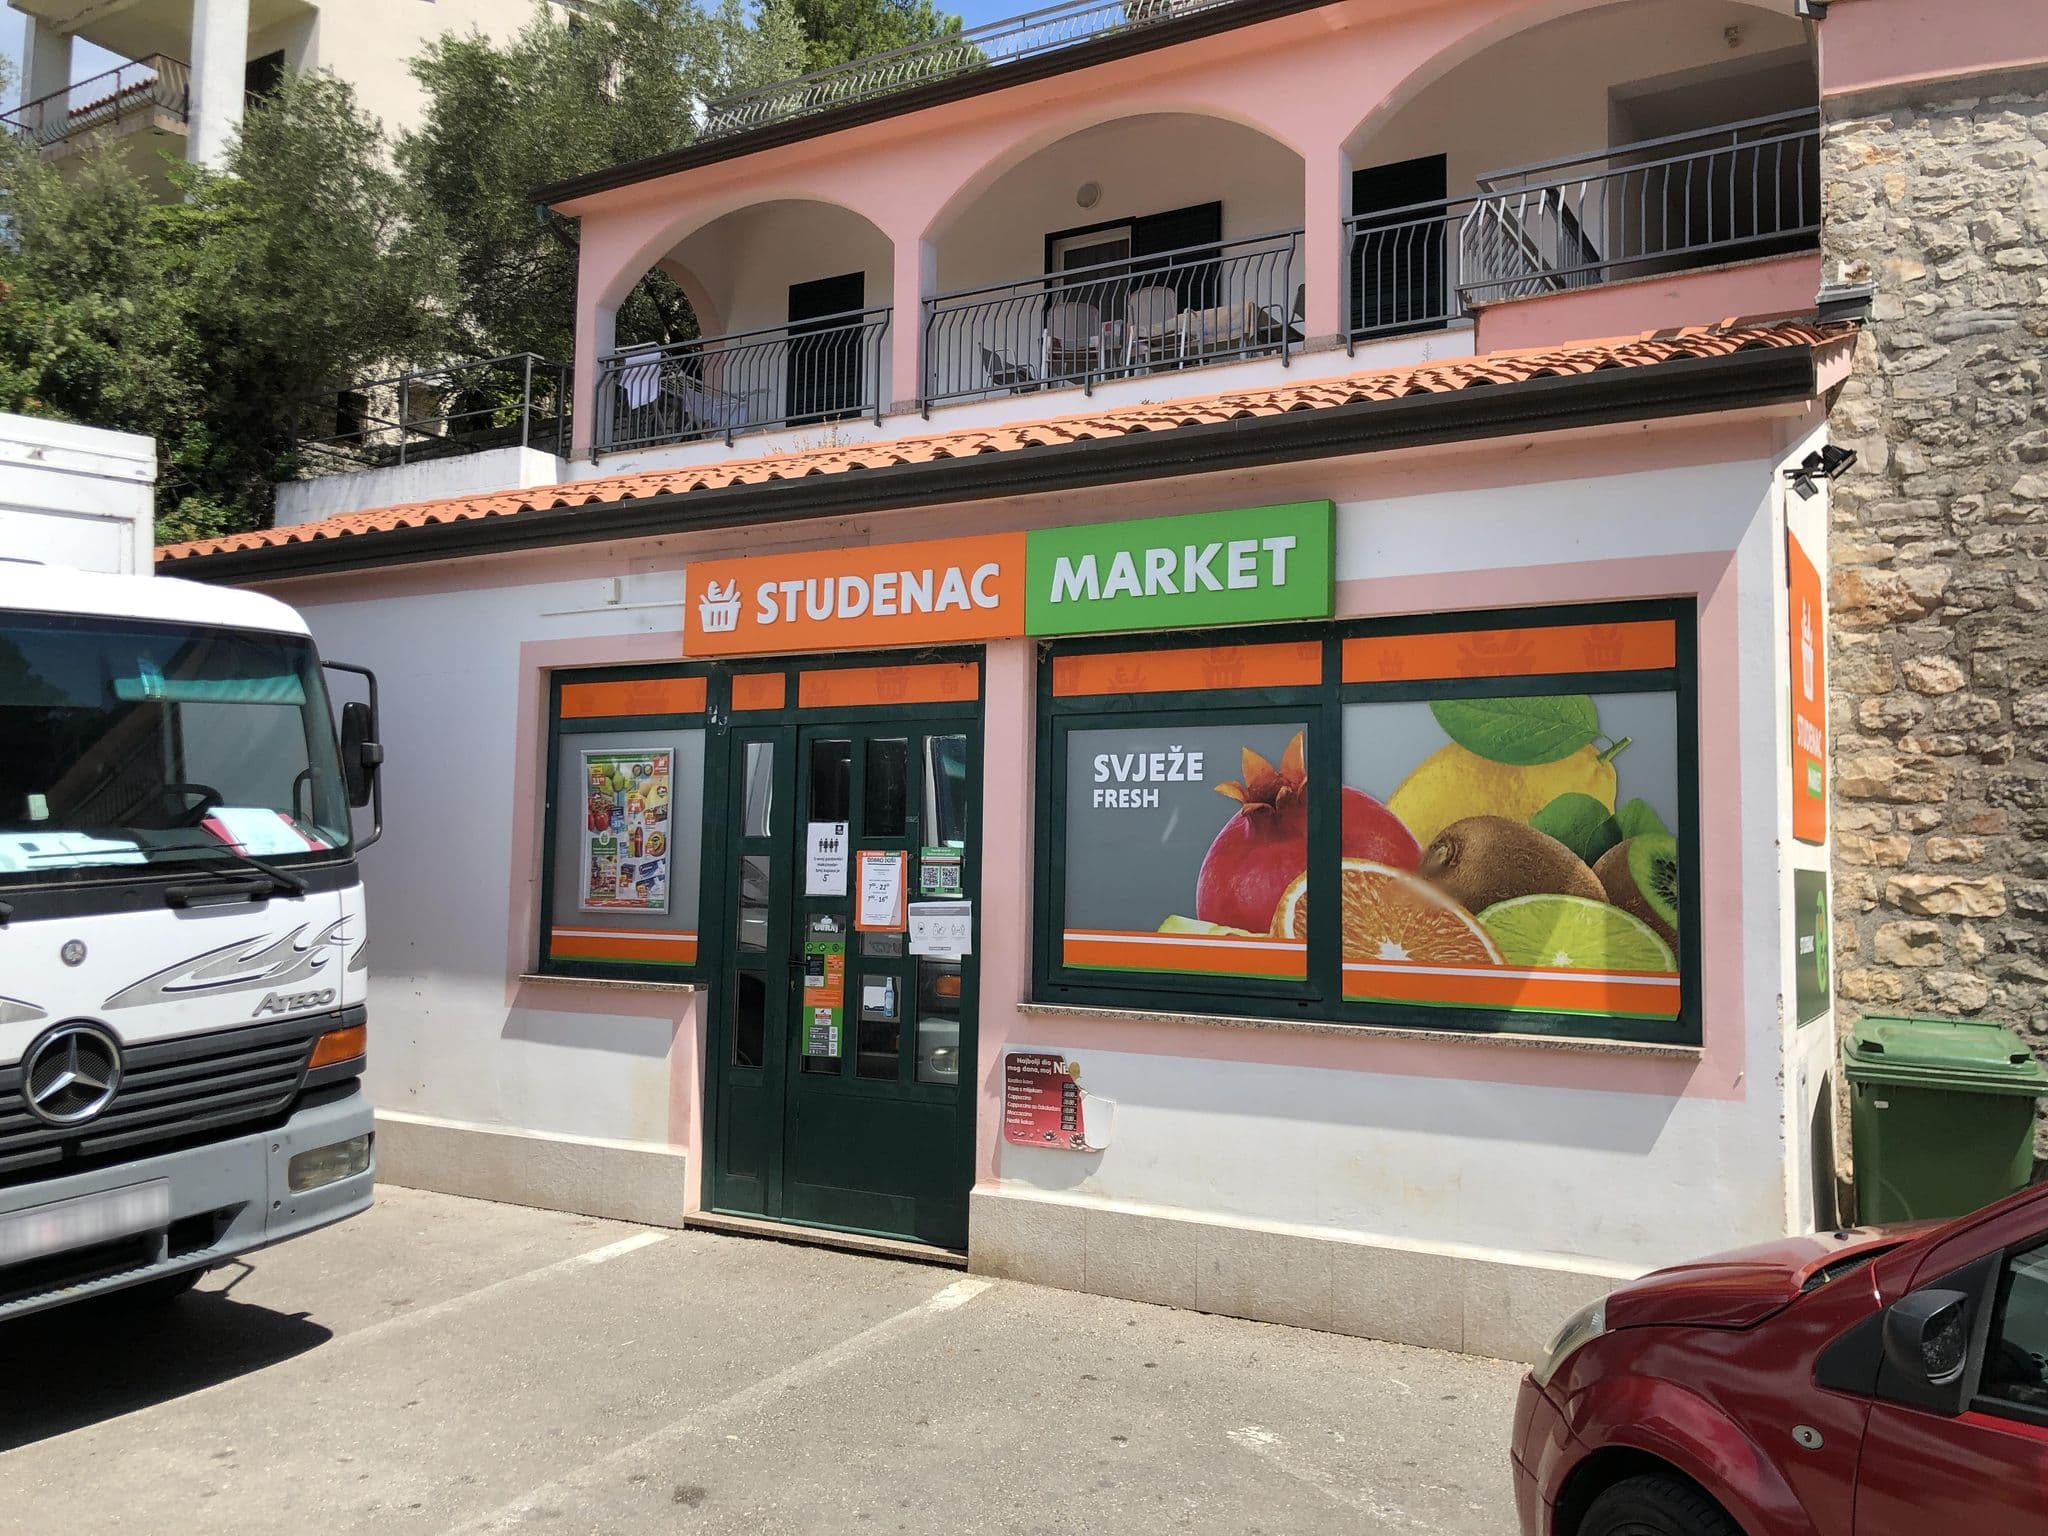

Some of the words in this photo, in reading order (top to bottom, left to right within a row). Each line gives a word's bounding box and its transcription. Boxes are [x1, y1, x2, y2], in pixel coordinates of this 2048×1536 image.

[756, 562, 1000, 625] STUDENAC
[1050, 535, 1297, 603] MARKET
[1093, 745, 1204, 782] SVJEŽE
[1093, 788, 1159, 808] FRESH
[822, 874, 830, 882] 5
[1017, 1058, 1040, 1066] Najbolji
[1040, 1066, 1052, 1075] moj
